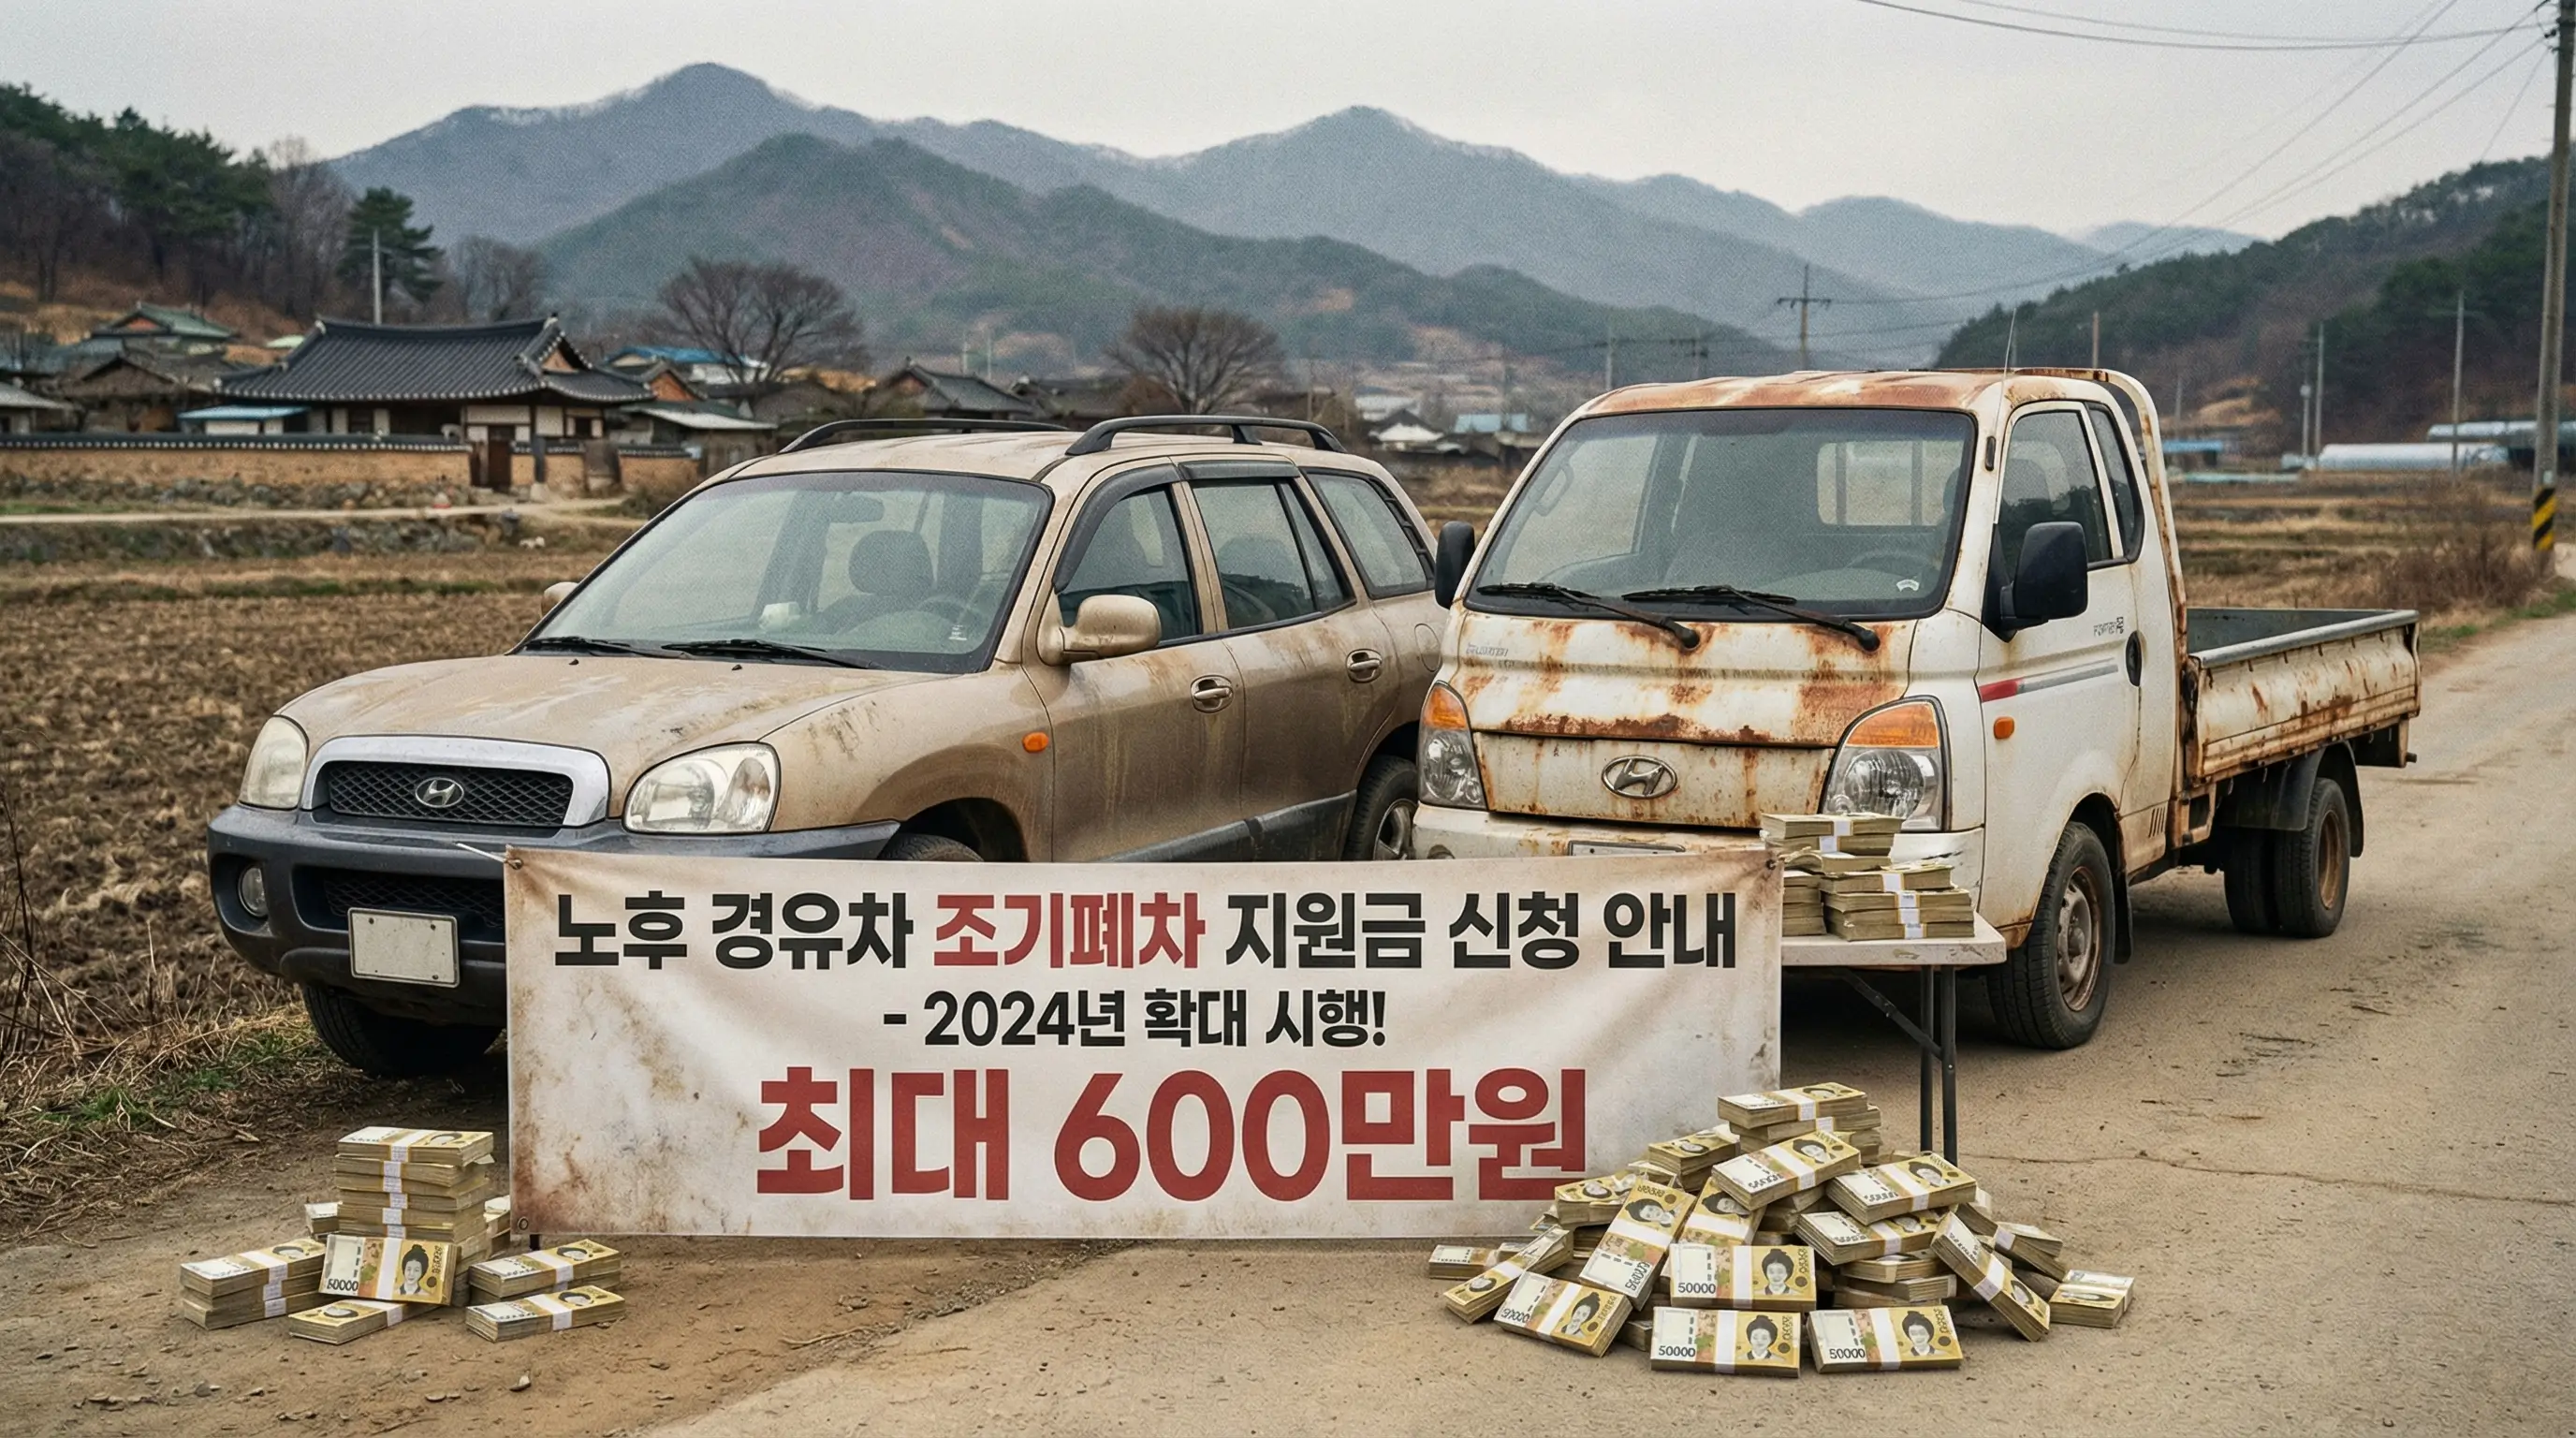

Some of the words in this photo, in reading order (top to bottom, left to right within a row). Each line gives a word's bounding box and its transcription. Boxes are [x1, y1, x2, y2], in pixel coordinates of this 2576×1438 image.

[555, 890, 688, 970] 노후
[712, 892, 914, 970] 경유차
[934, 893, 1206, 969] 조기폐차
[1225, 892, 1426, 969] 지원금
[1449, 891, 1580, 970] 신청
[1603, 892, 1735, 969] 안내
[924, 990, 1125, 1047] 2024년
[1144, 988, 1247, 1048] 확대
[1266, 989, 1385, 1048] 시행!
[757, 1067, 1008, 1199] 최대
[1054, 1067, 1586, 1201] 600만원
[1677, 1282, 1717, 1294] 50000
[1658, 1345, 1696, 1357] 50000
[1829, 1348, 1866, 1359] 50000
